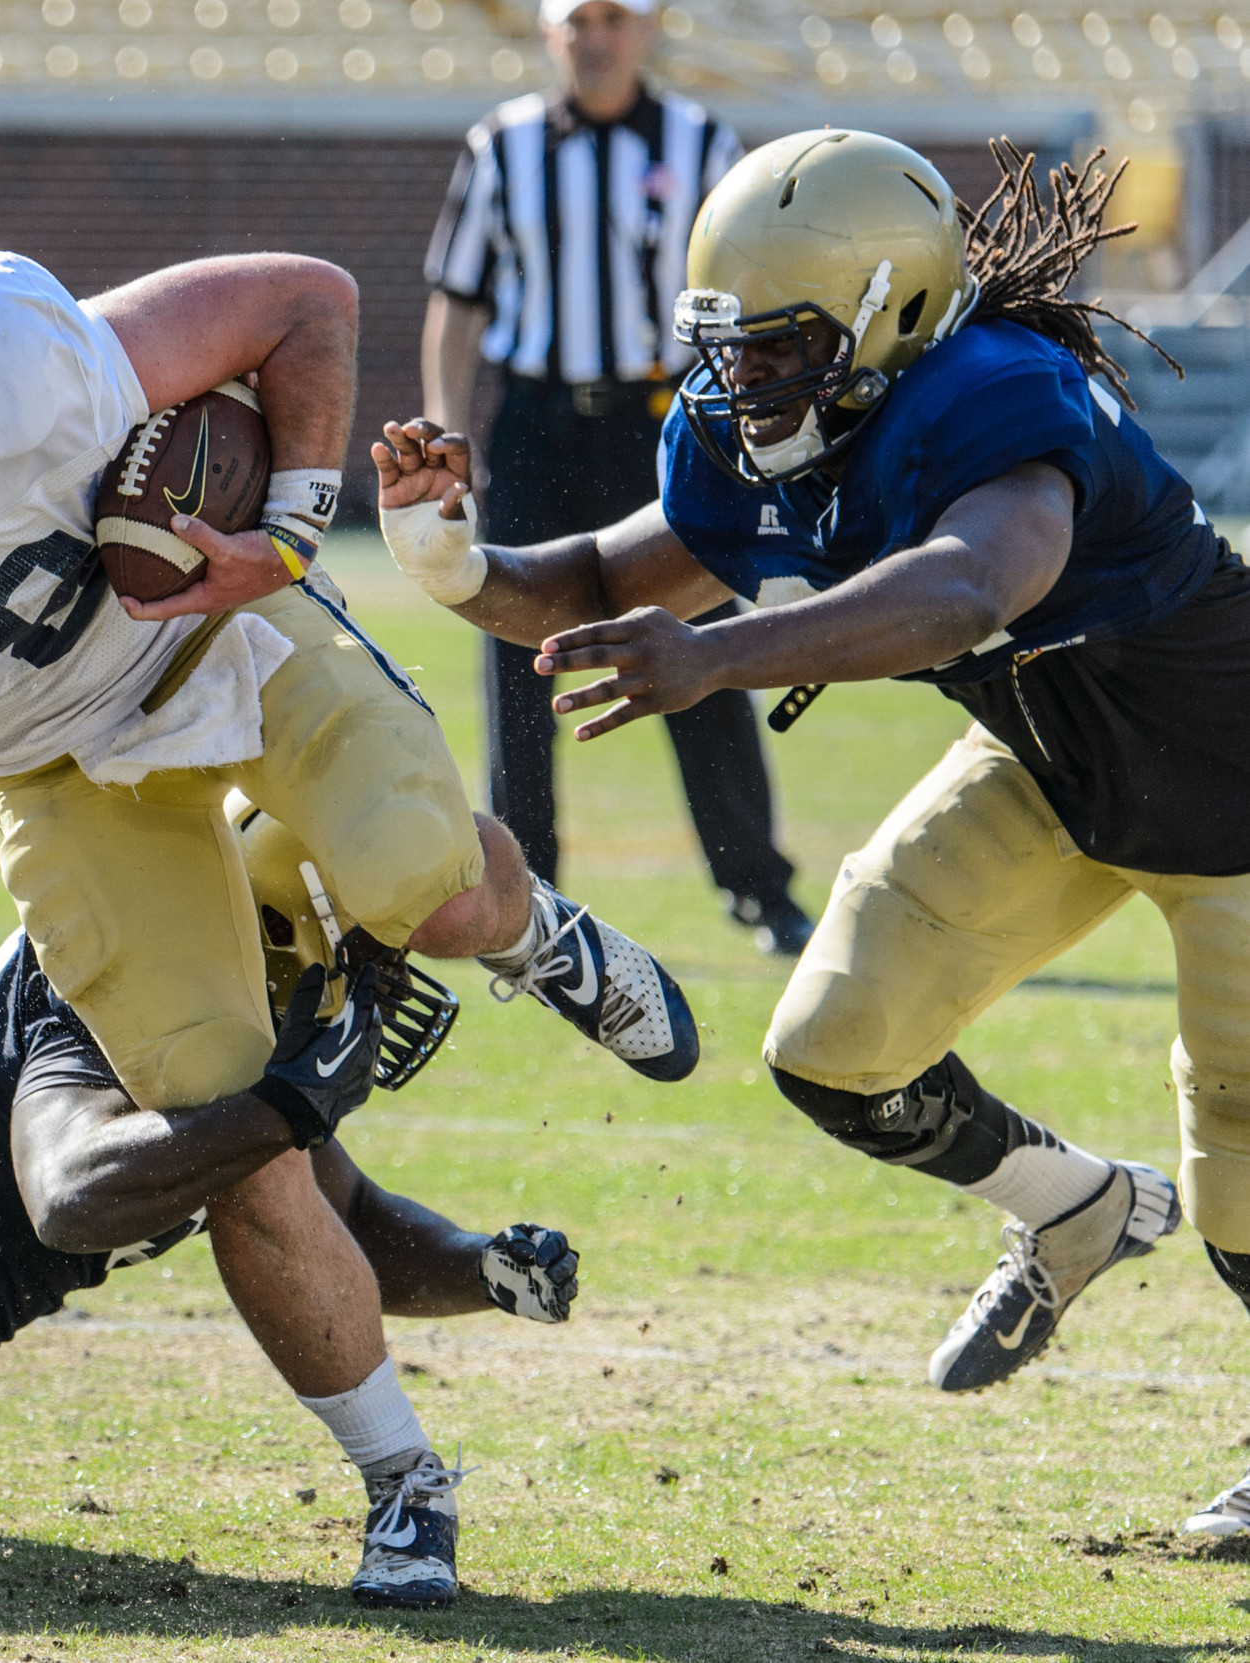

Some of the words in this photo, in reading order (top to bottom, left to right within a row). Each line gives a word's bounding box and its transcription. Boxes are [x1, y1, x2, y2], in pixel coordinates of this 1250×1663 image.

[309, 481, 338, 493] SSELL
[312, 492, 336, 516] R
[760, 504, 779, 527] R
